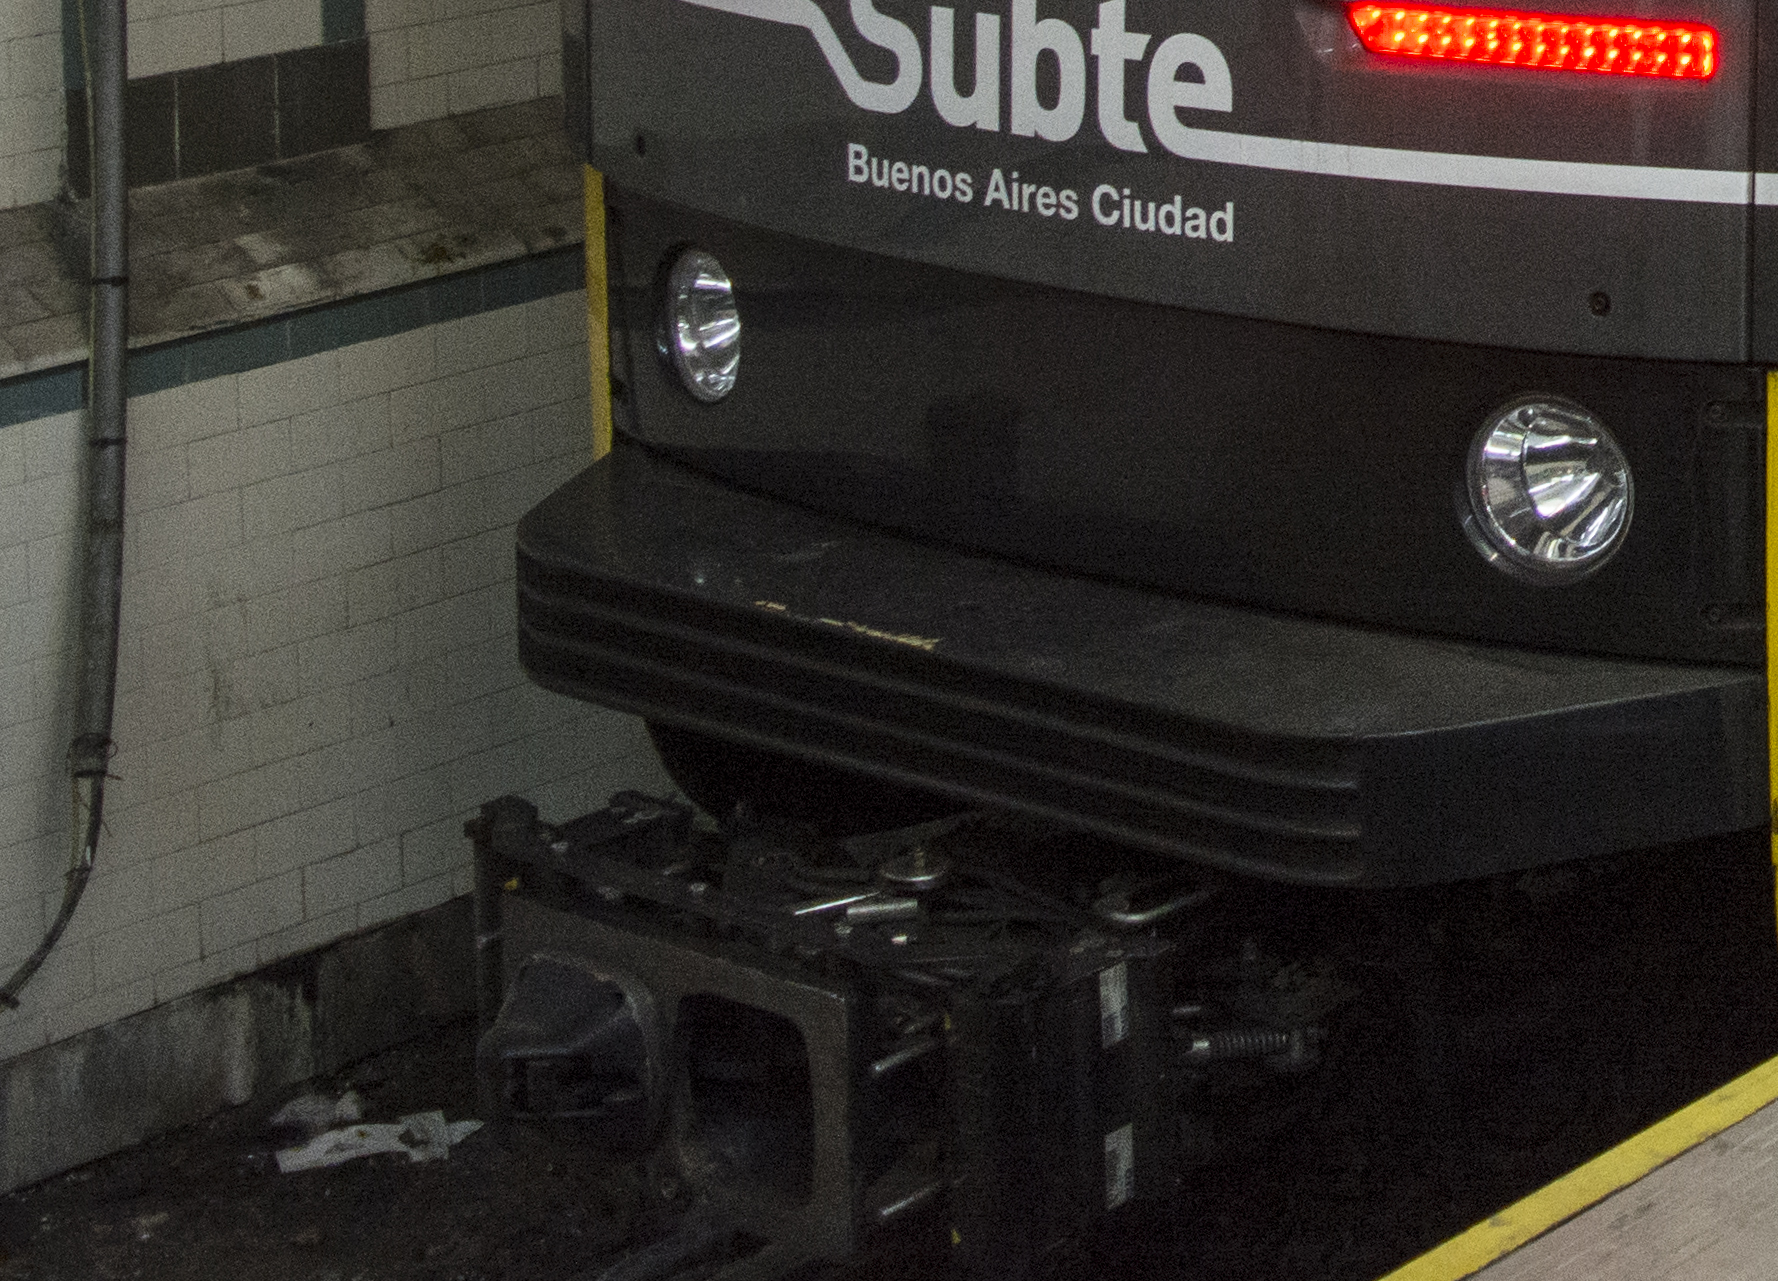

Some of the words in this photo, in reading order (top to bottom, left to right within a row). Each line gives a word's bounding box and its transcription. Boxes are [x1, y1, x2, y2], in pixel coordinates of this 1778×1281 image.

[846, 142, 974, 204] Buenos
[983, 167, 1080, 221] Aires
[1090, 183, 1235, 243] Ciudad
